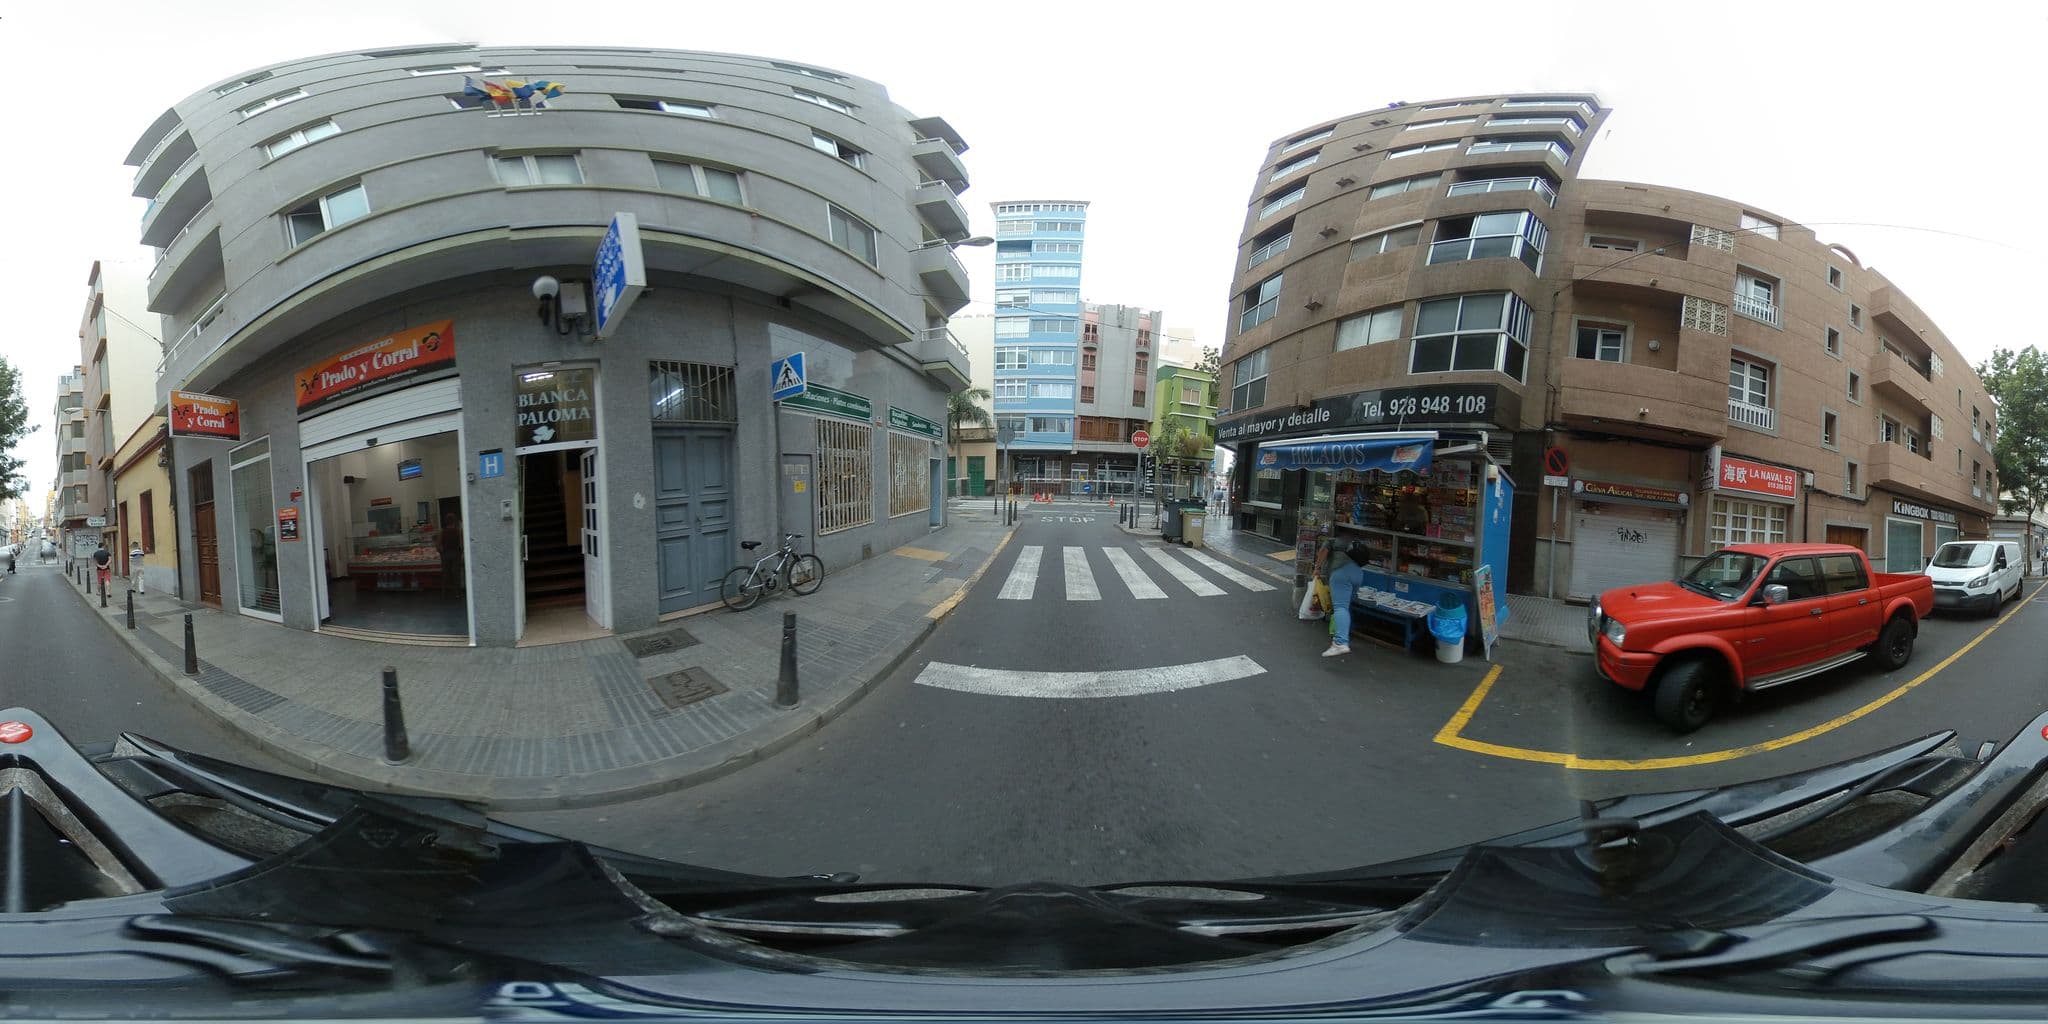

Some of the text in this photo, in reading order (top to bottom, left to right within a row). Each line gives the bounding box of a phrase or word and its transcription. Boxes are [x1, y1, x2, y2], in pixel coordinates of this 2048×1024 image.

[321, 364, 356, 390] Prado
[359, 361, 369, 381] y
[372, 339, 420, 370] Corral
[518, 388, 591, 408] BLANCA
[1362, 396, 1486, 417] Tel. 928 948 108
[193, 403, 219, 416] Prado
[518, 406, 592, 426] PALOMA
[187, 415, 225, 428] y Corral
[1219, 407, 1331, 439] Venta al mayor y detalle
[1290, 443, 1366, 465] HELADOS
[1749, 468, 1793, 485] LA NAVAL 52
